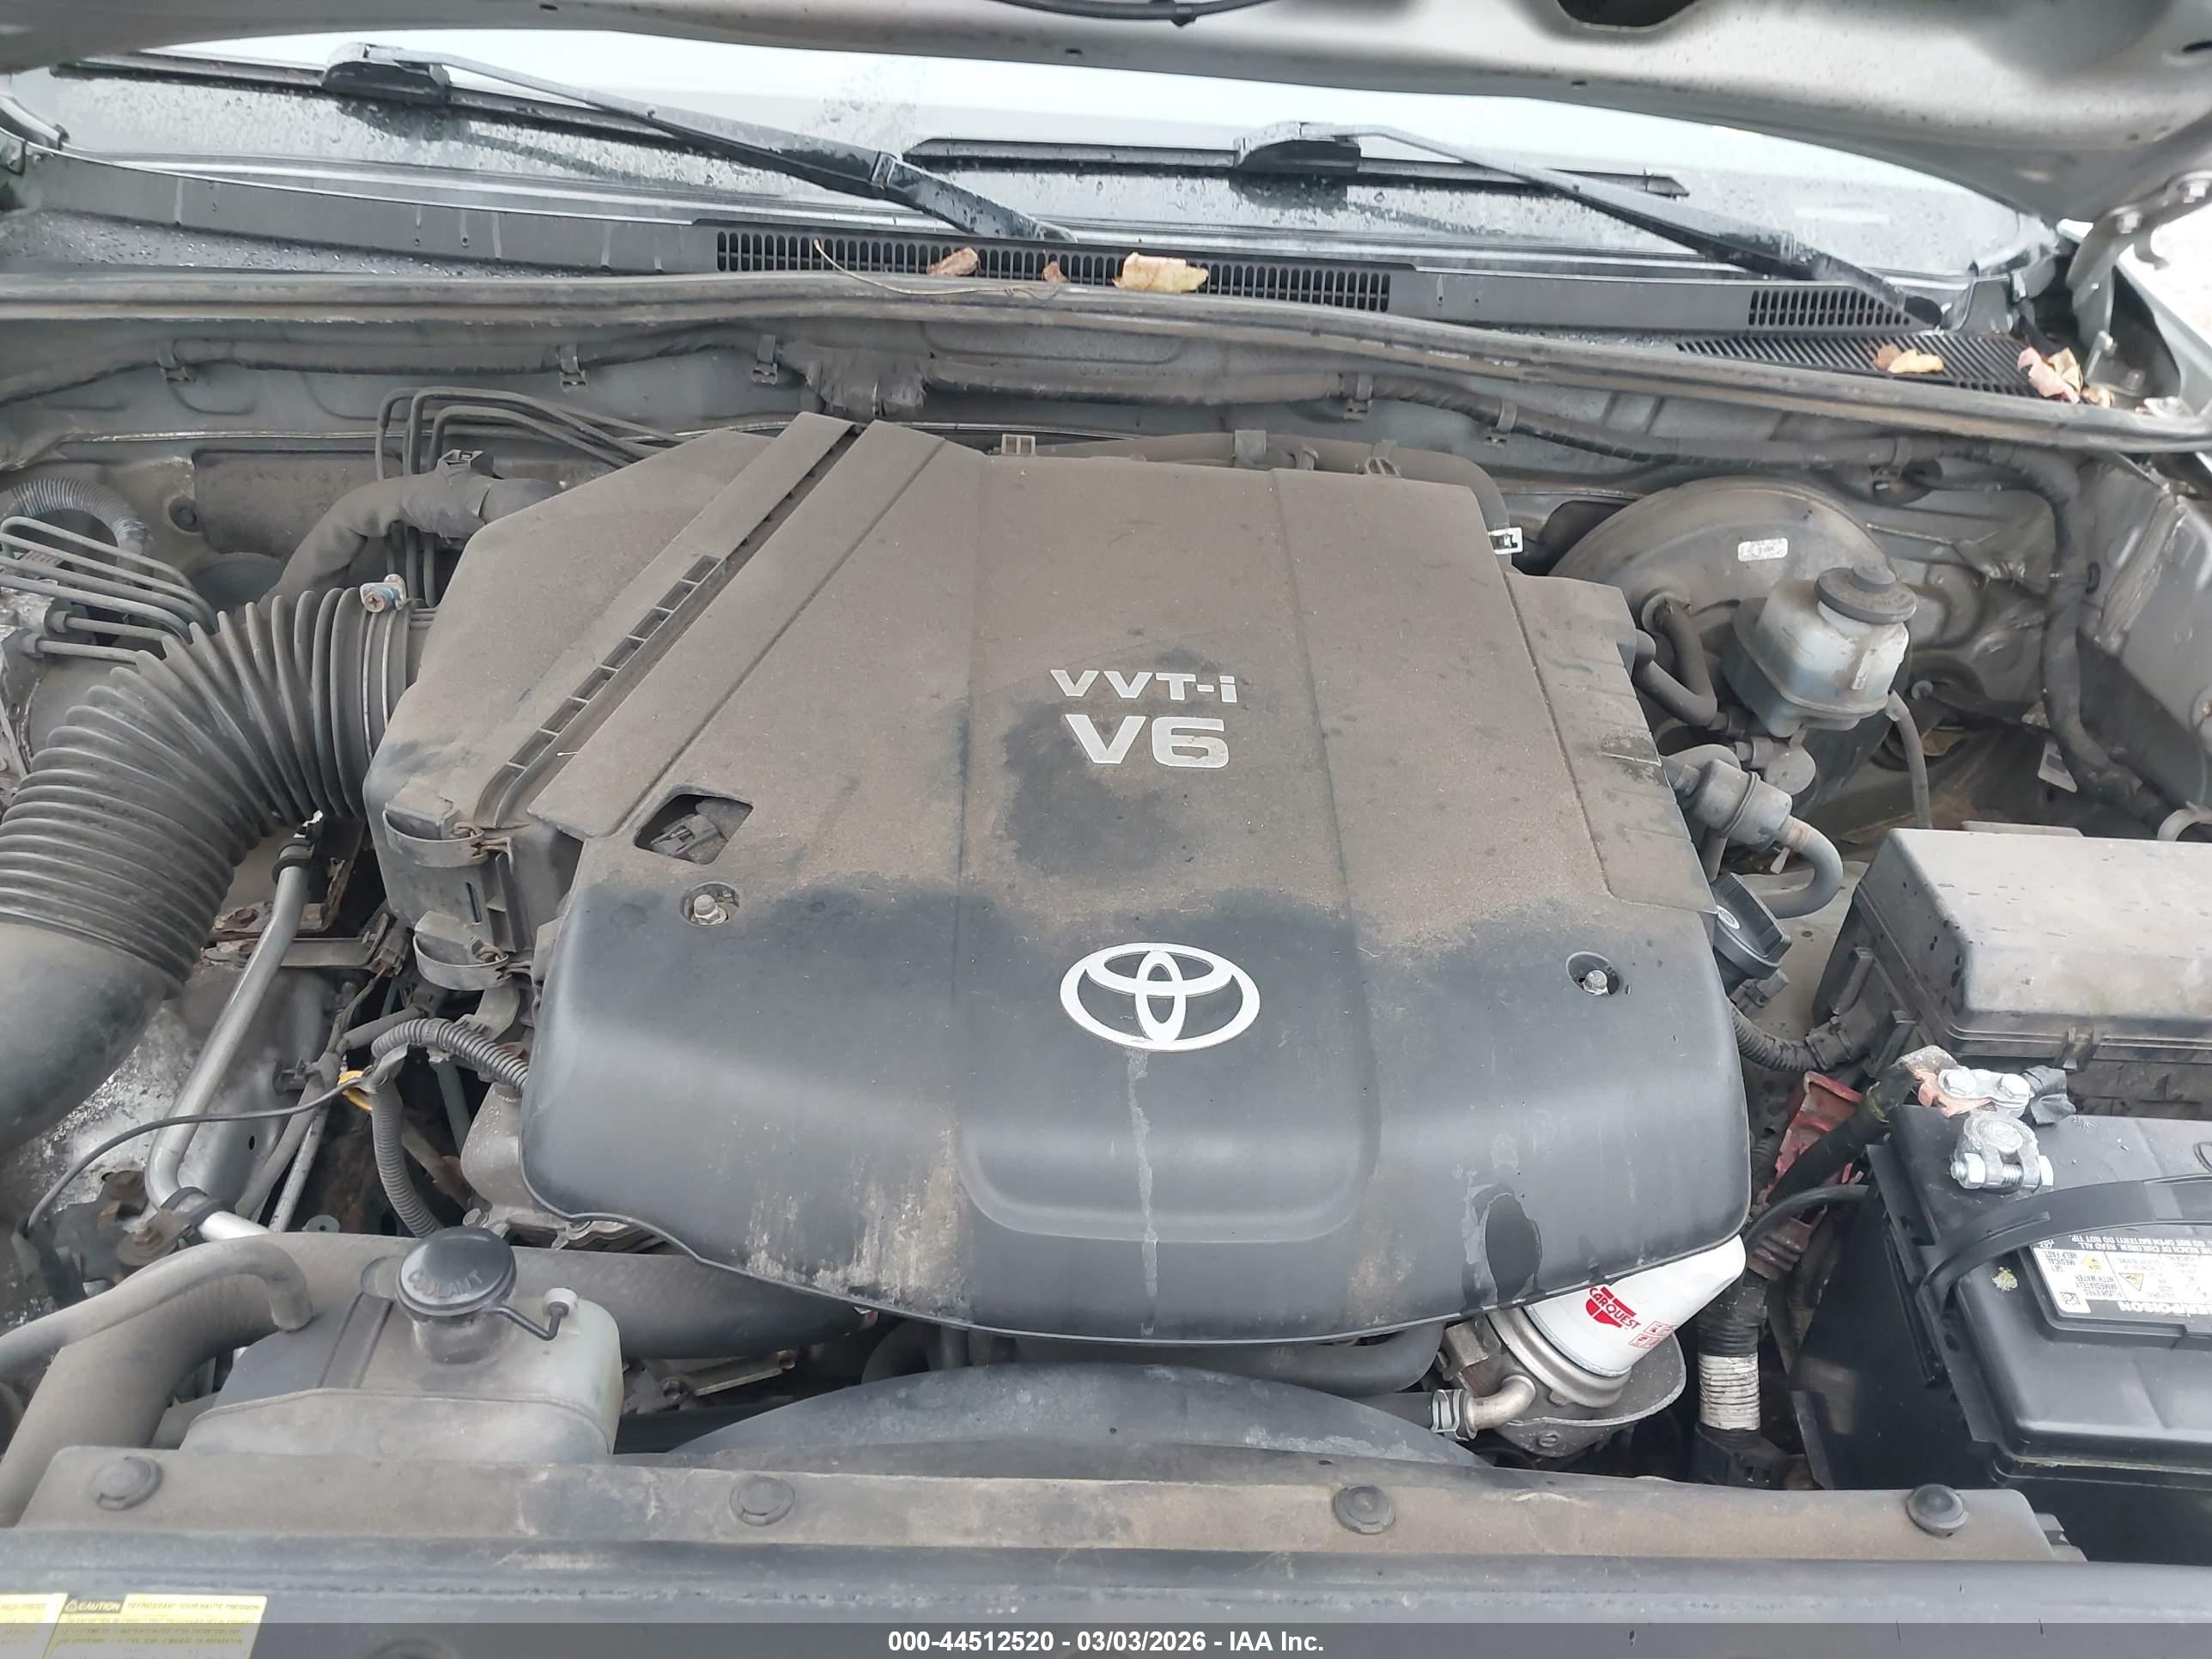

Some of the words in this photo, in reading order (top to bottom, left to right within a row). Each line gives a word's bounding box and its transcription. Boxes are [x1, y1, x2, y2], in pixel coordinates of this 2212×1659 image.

[1049, 669, 1237, 703] VVT-i
[1064, 714, 1230, 769] V6
[1589, 1288, 1642, 1329] CARQUEST
[78, 1601, 120, 1611] CAUTION
